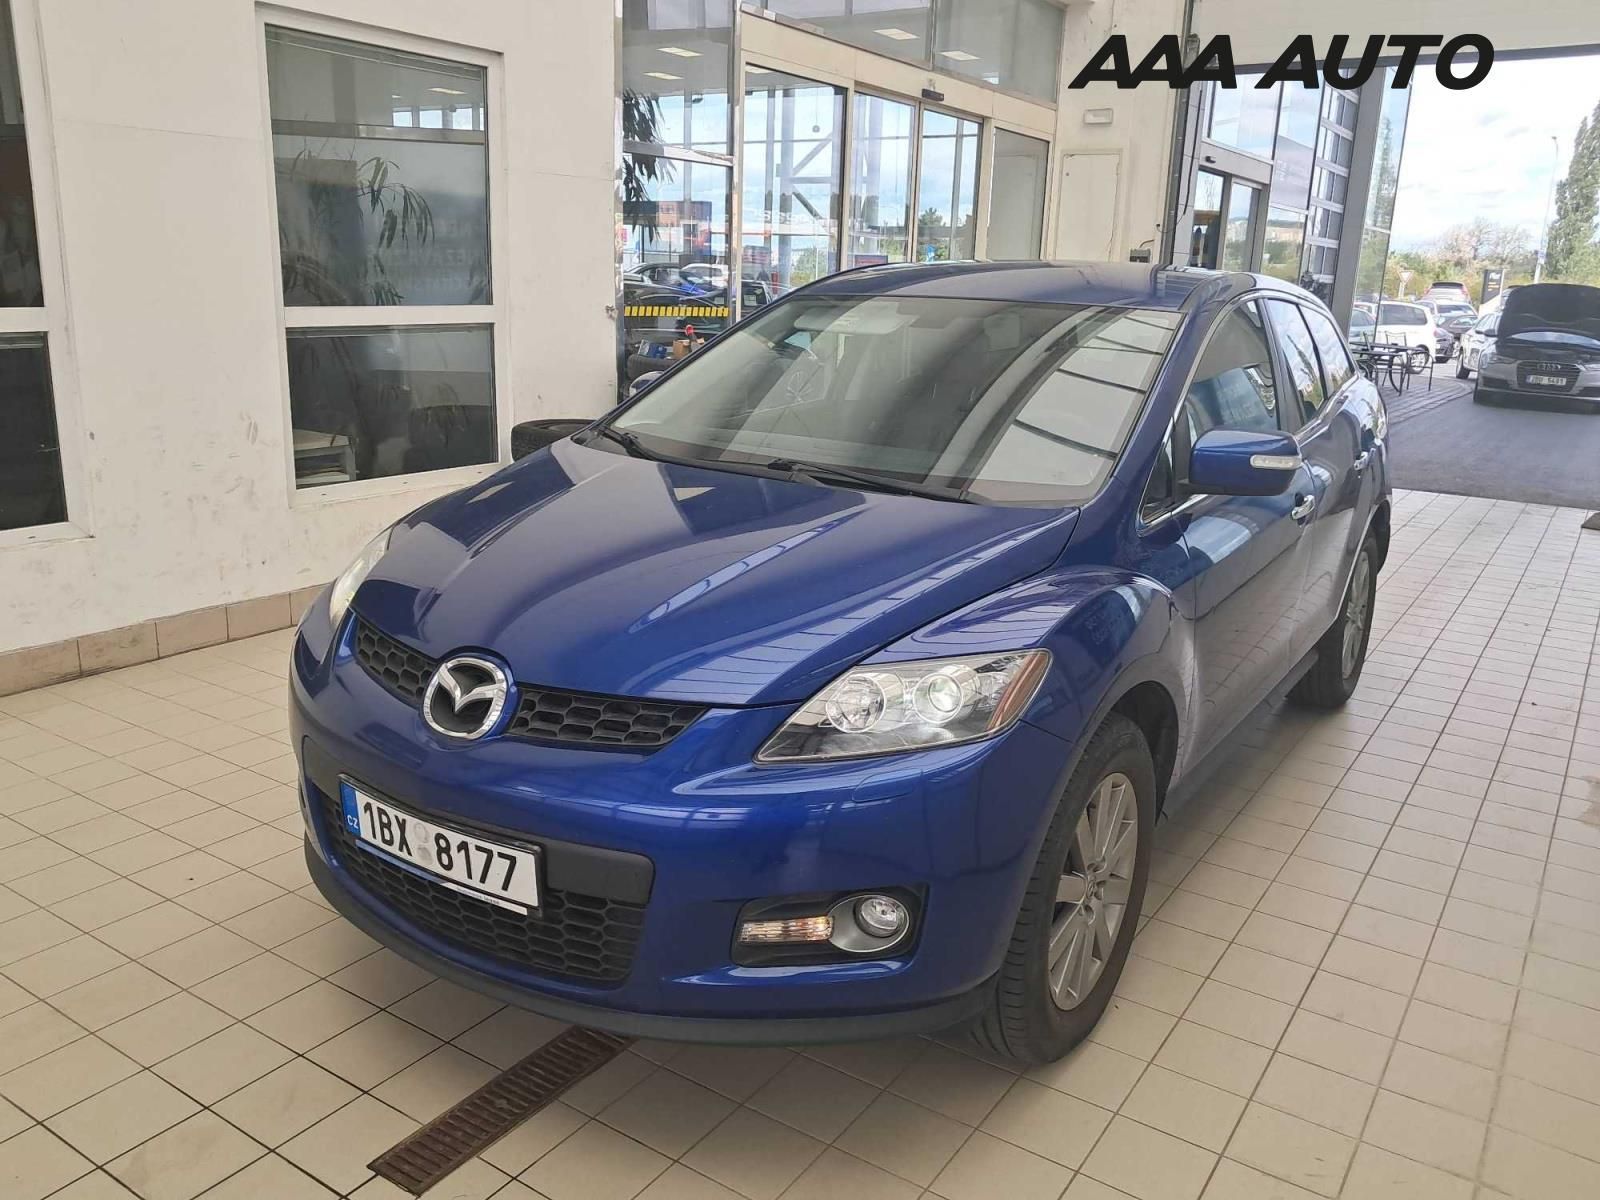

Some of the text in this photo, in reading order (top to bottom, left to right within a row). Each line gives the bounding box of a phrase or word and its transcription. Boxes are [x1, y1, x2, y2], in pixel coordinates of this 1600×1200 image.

[347, 814, 359, 830] CZ
[363, 801, 517, 892] 1BX 8177
